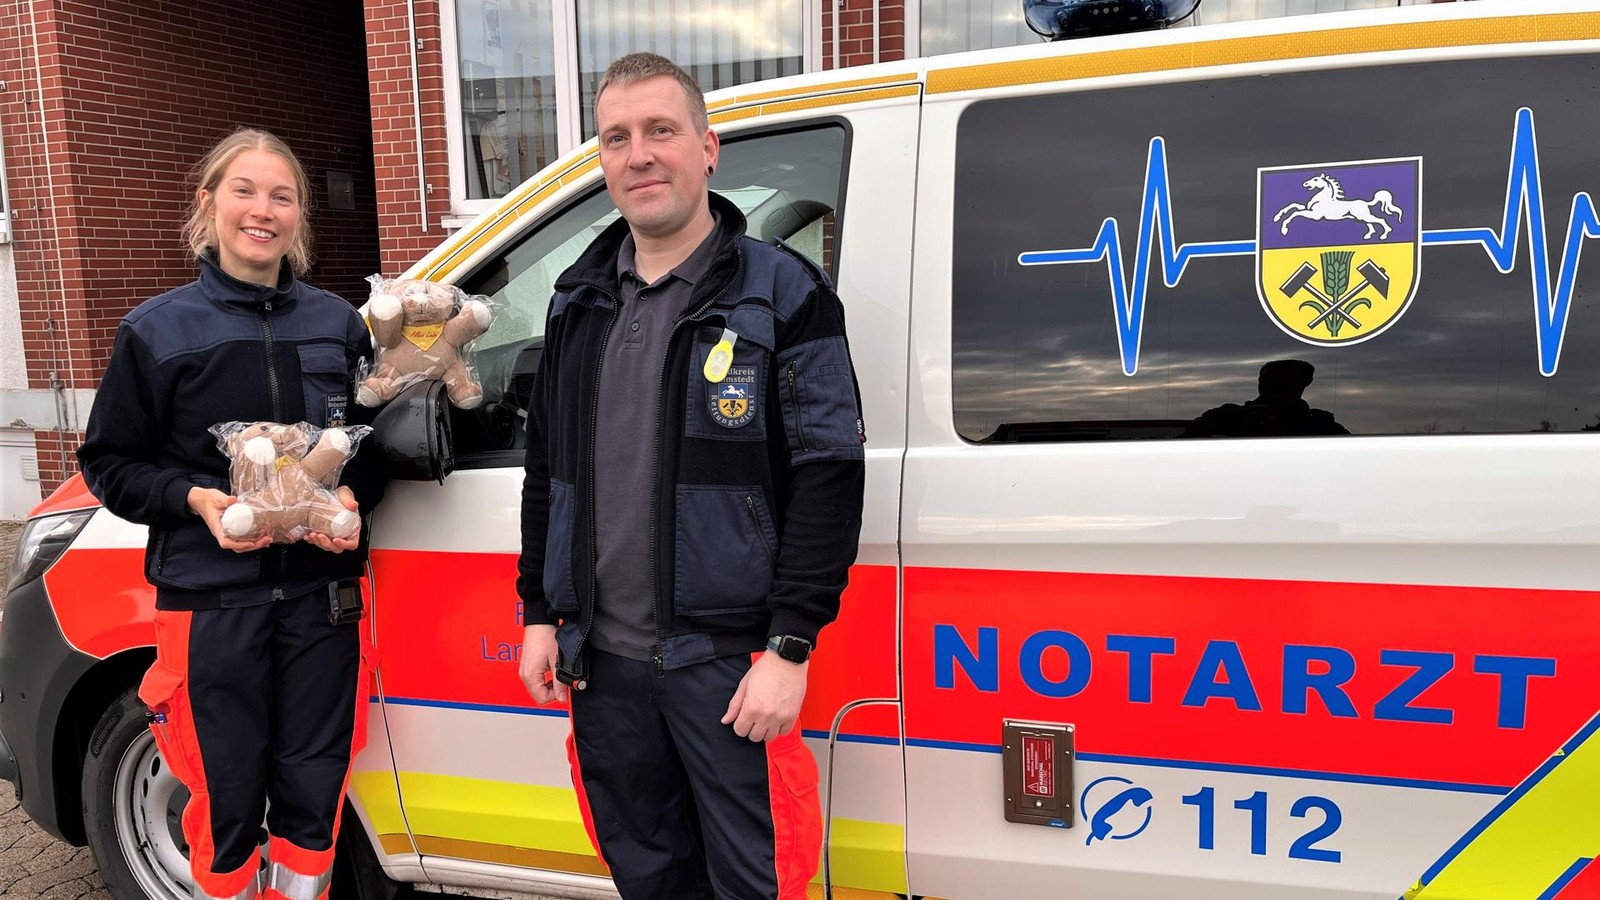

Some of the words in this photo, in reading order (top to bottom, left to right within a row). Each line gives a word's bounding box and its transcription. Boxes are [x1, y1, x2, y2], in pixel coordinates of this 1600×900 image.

[723, 375, 755, 383] mstedt
[727, 367, 755, 375] dkreis
[711, 394, 755, 427] Rettungsdienst
[935, 625, 1554, 728] NOTARZT
[1182, 787, 1342, 863] 112
